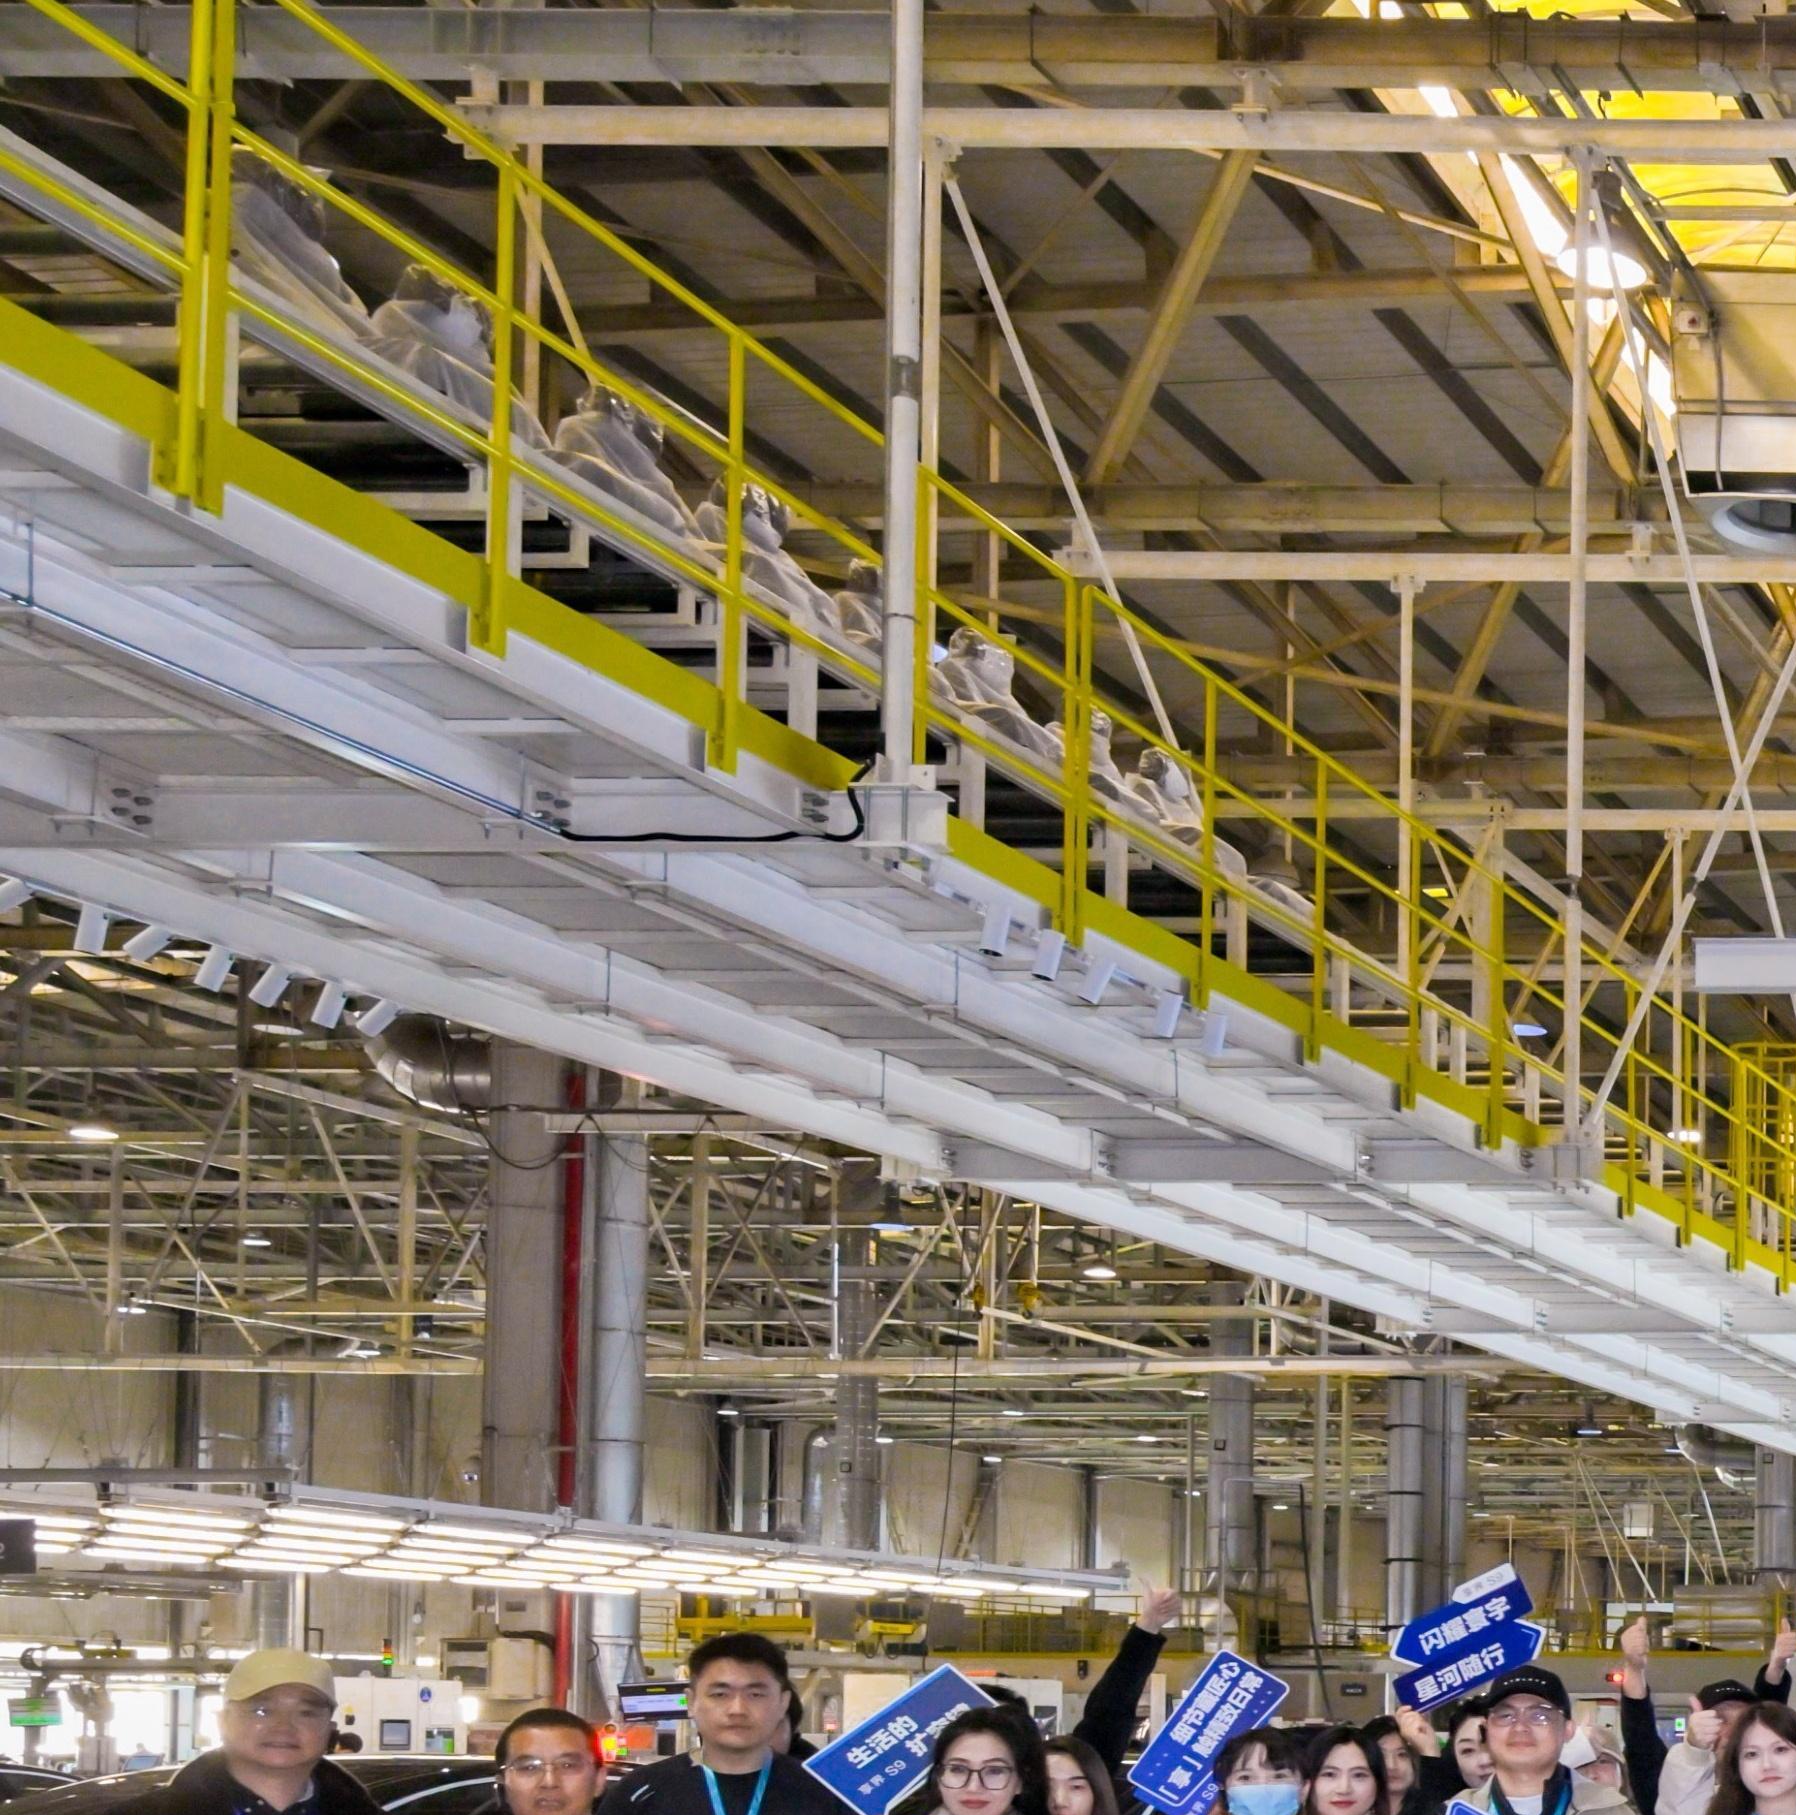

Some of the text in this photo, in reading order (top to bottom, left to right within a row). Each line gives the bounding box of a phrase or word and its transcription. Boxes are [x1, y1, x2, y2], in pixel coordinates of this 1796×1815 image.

[1414, 1642, 1505, 1703] 星河随行
[846, 1715, 919, 1769] 生活的
[884, 1759, 907, 1777] S9
[1202, 1783, 1219, 1801] S9
